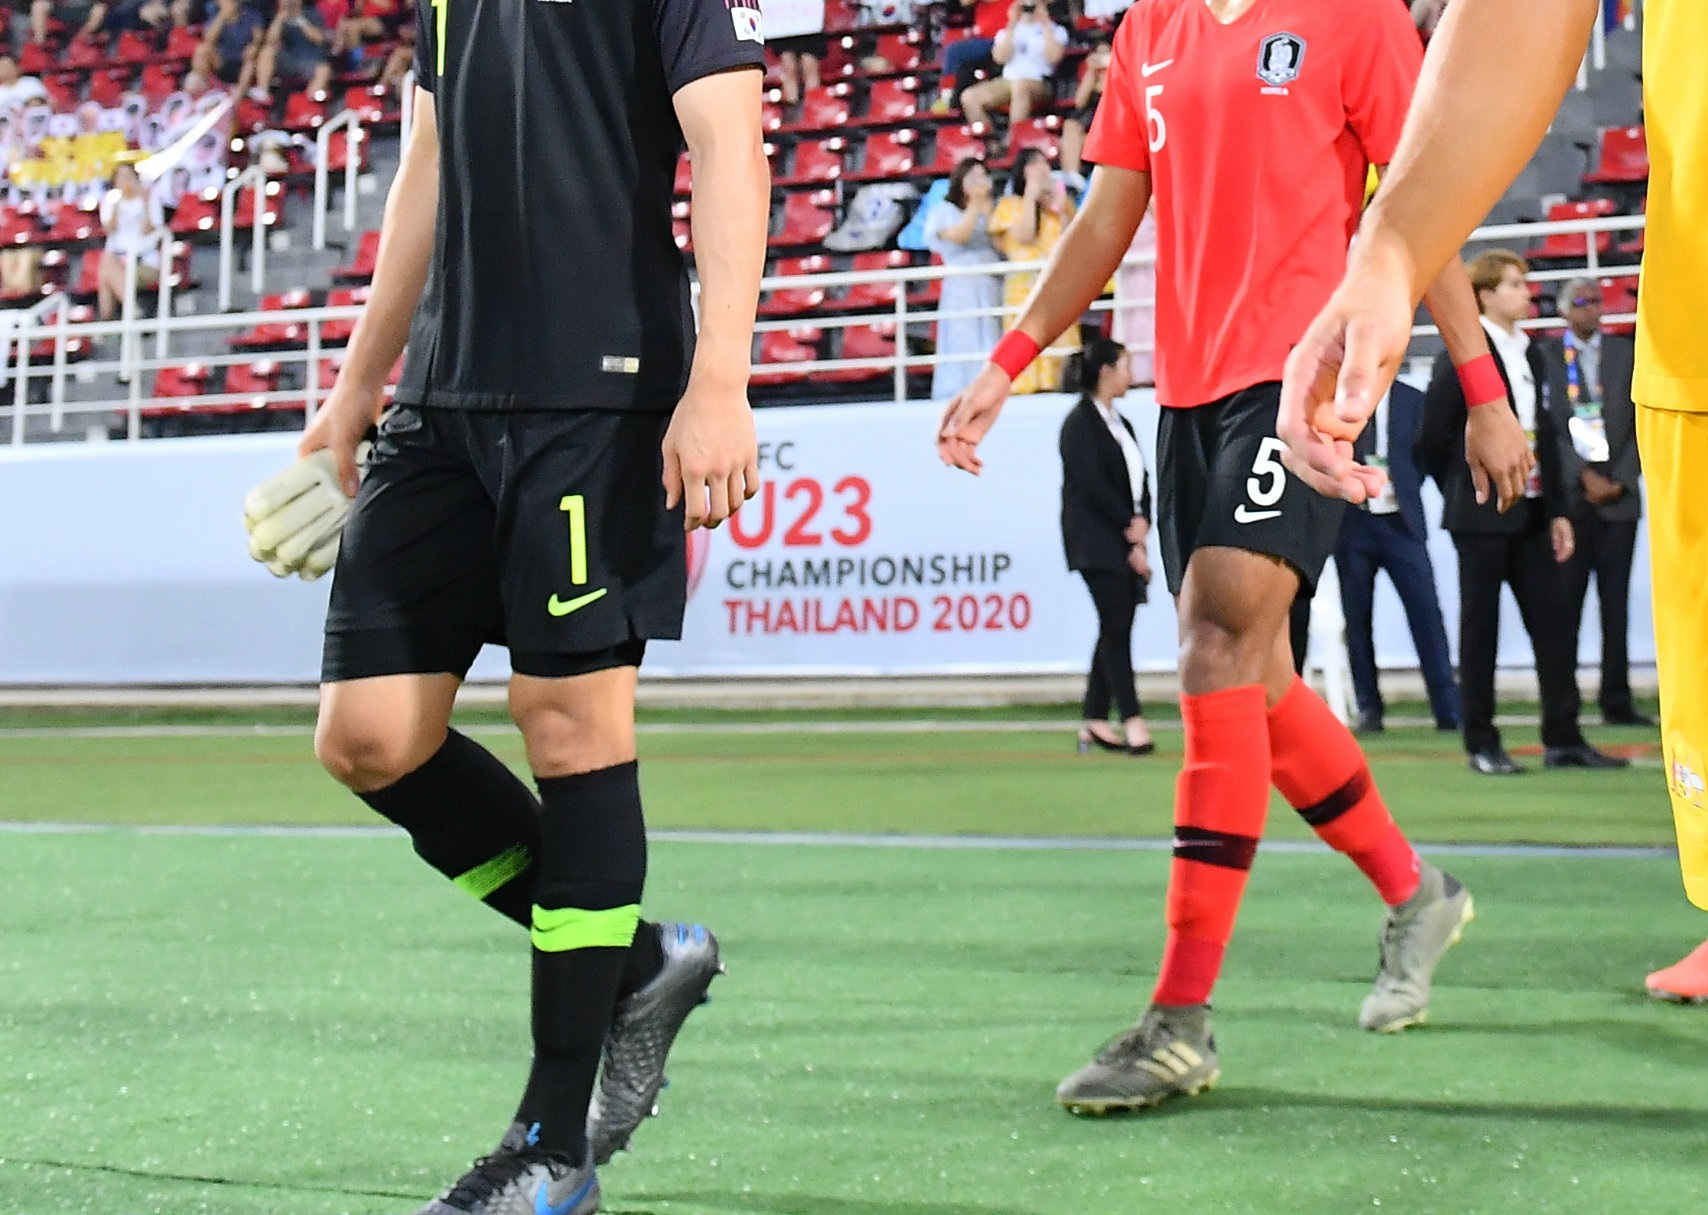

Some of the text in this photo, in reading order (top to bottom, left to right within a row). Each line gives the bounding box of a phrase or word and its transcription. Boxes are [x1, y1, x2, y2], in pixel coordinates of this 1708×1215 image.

[1145, 84, 1167, 153] 5
[1246, 436, 1287, 506] 5
[558, 494, 588, 585] 1
[727, 474, 873, 550] U23
[726, 552, 1011, 589] CHAMPIONSHIP
[722, 591, 1032, 634] THAILAND 2020
